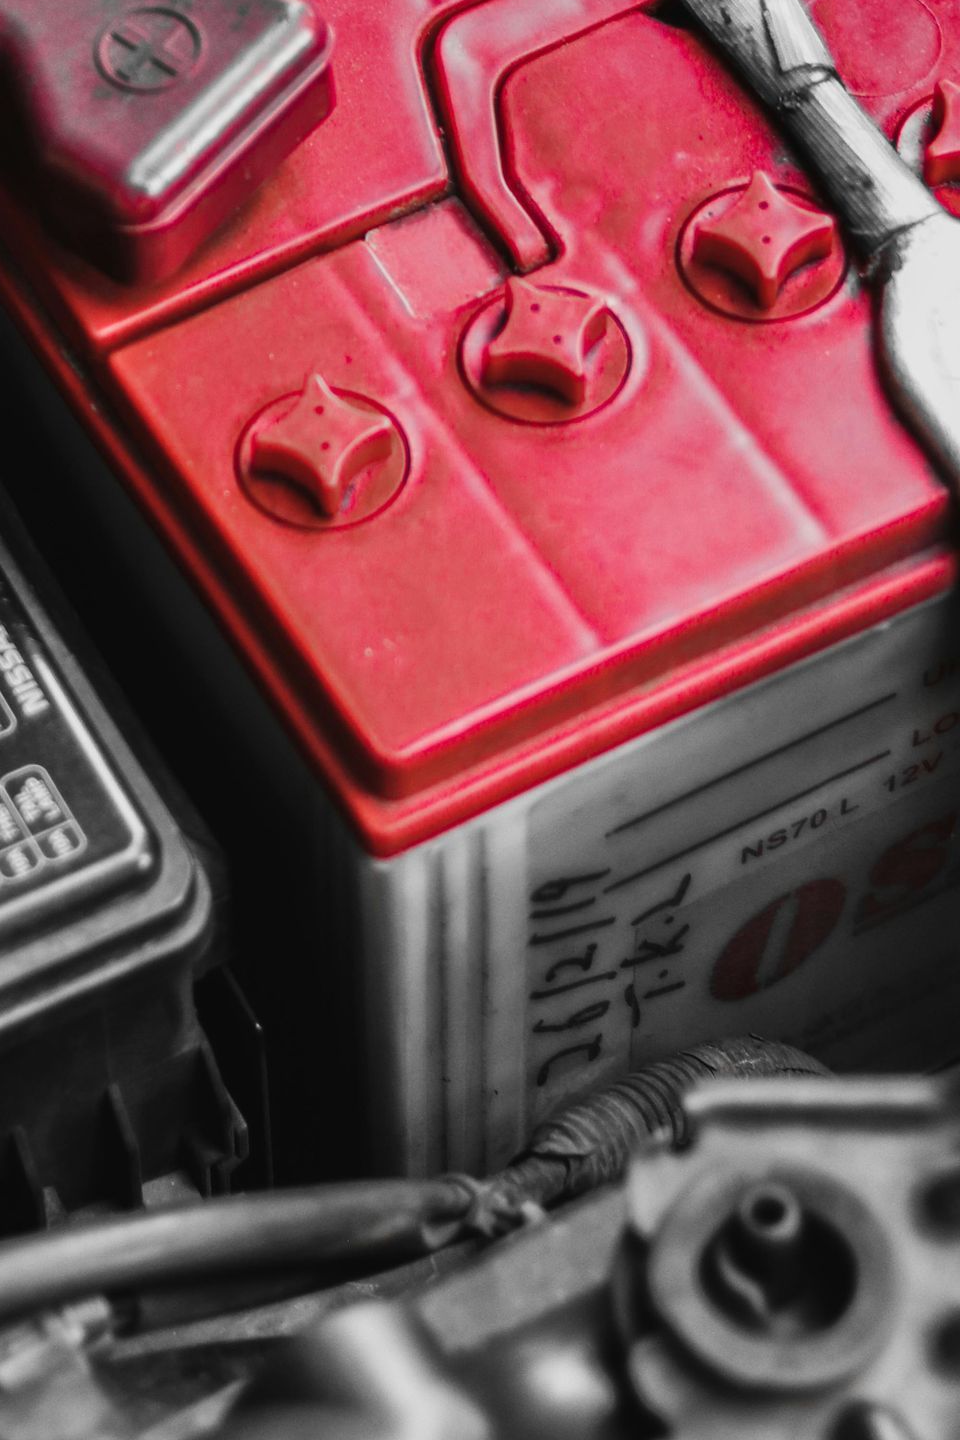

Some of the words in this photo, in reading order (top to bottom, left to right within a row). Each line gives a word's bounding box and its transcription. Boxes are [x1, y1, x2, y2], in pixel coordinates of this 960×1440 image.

[740, 809, 827, 864] NS70
[839, 798, 859, 818] L
[883, 752, 944, 793] 12V
